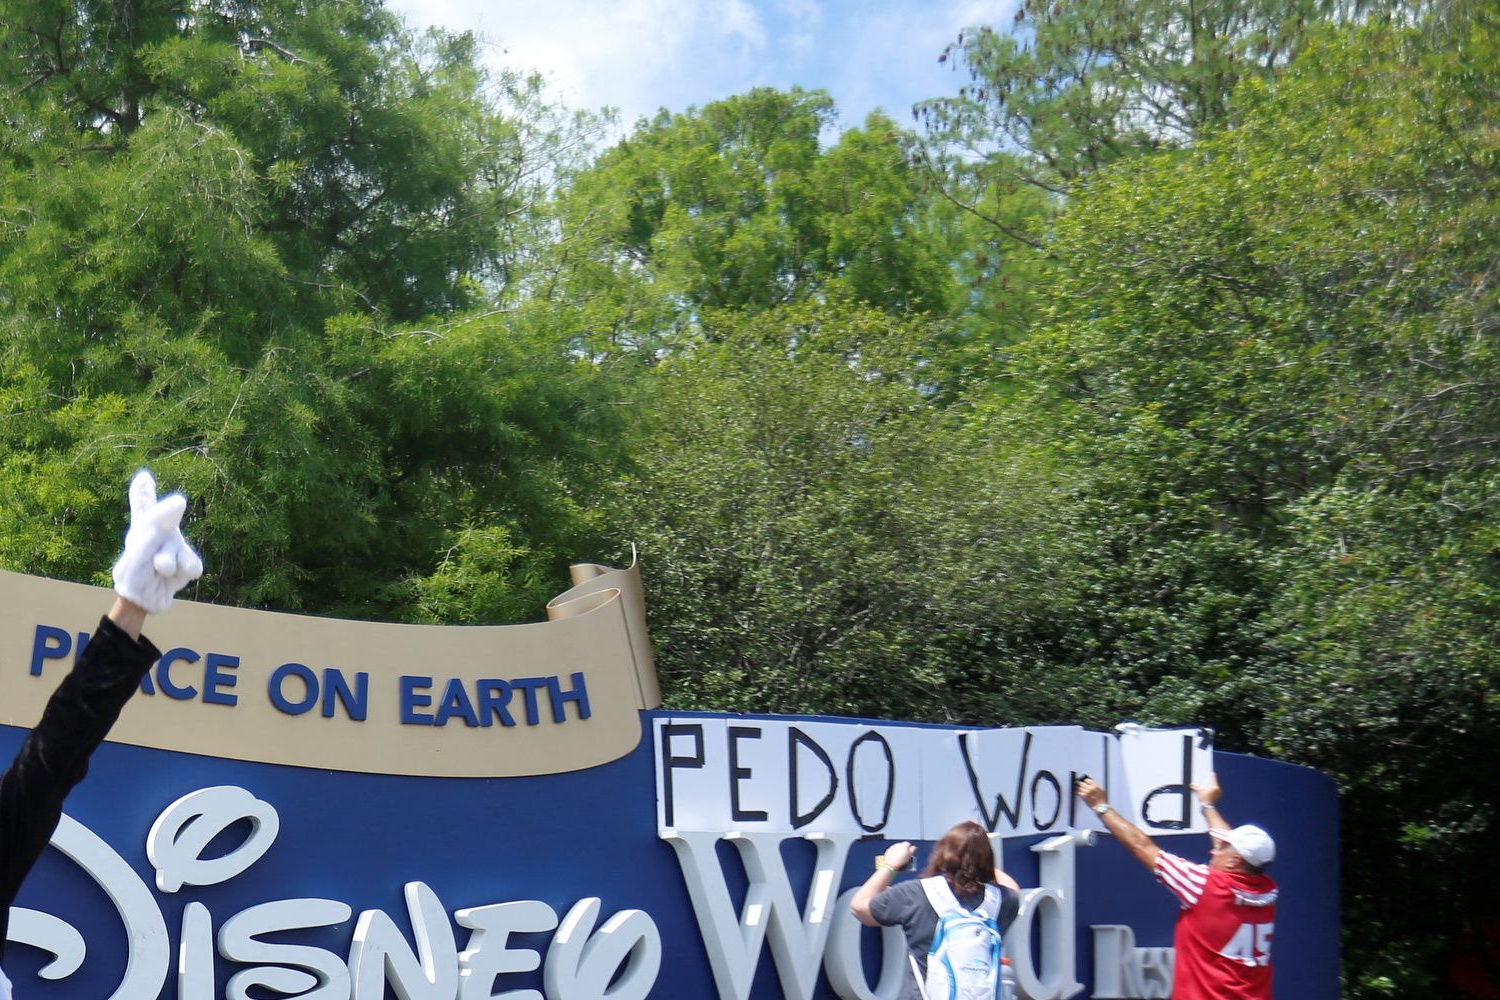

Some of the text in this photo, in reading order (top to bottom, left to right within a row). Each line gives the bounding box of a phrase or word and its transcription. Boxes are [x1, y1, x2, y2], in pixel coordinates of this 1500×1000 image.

[29, 623, 240, 706] PCE
[268, 663, 369, 722] ON
[401, 672, 592, 728] EARTH
[661, 722, 896, 833] PEDO
[1220, 922, 1275, 968] 45
